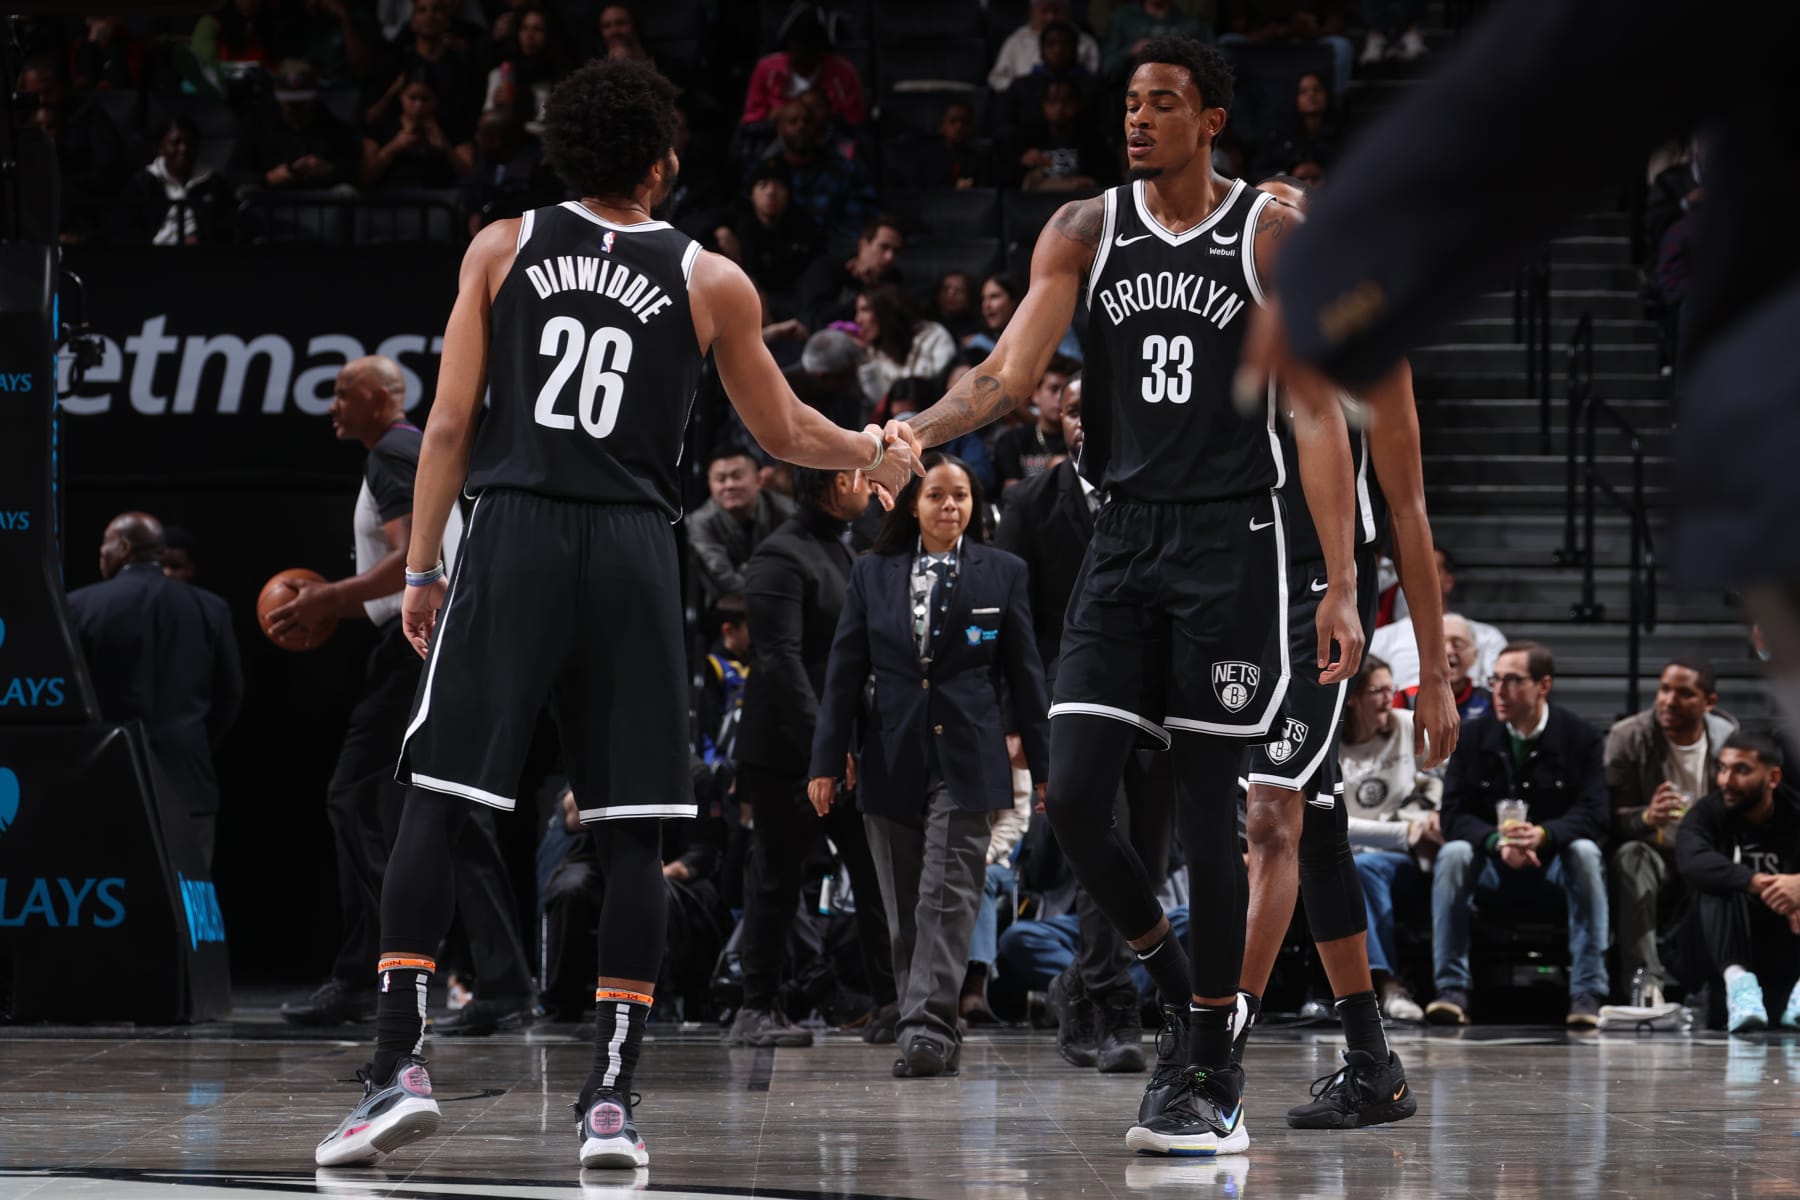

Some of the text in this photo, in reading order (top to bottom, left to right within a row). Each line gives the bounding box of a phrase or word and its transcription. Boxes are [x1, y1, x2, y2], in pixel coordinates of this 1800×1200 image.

[1209, 247, 1236, 257] Webull
[525, 256, 673, 324] DINWIDDIE
[1099, 271, 1245, 330] BROOKLYN
[58, 314, 443, 415] etmas
[534, 315, 634, 439] 26
[1141, 334, 1194, 404] 33
[0, 676, 65, 707] AYS
[1214, 663, 1257, 686] NETS
[1282, 719, 1305, 742] TS
